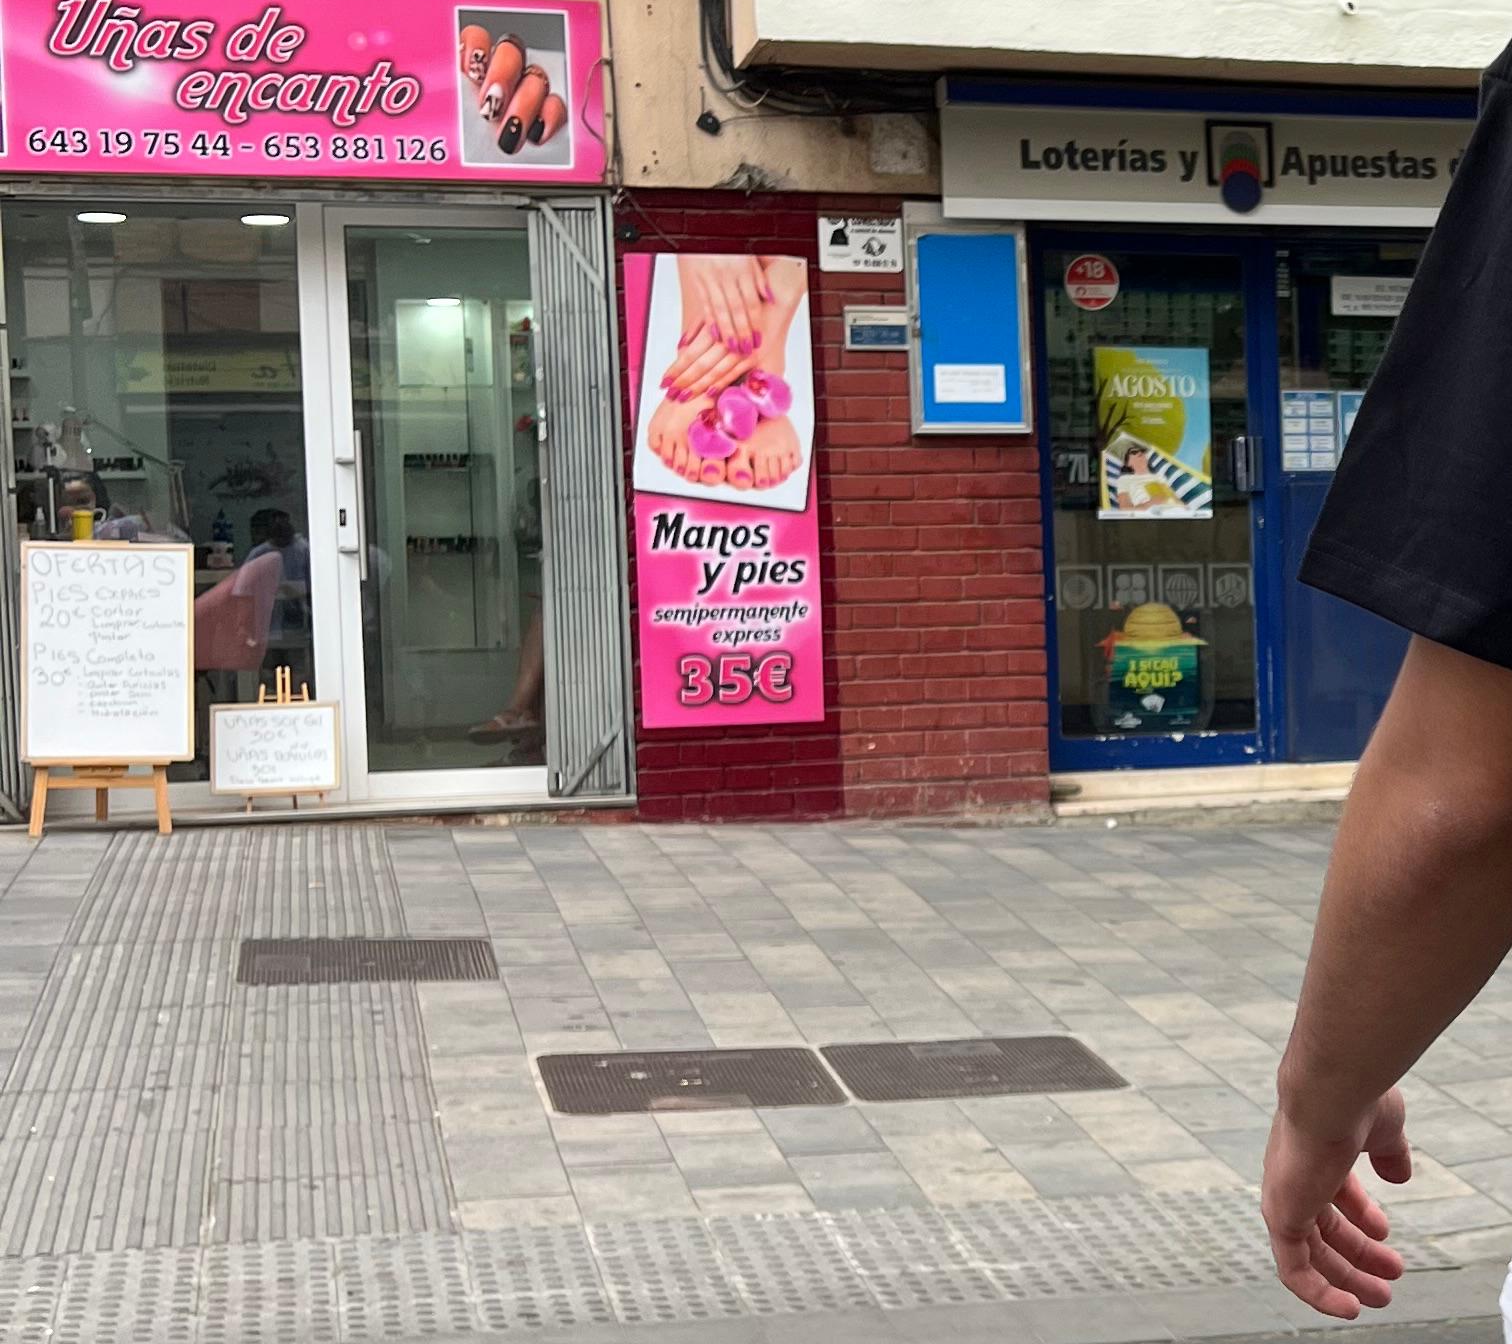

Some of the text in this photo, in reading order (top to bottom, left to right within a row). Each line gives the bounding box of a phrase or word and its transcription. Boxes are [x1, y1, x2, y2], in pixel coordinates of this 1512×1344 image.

[226, 6, 306, 64] de
[175, 61, 422, 126] encanto
[28, 129, 89, 155] 643
[99, 130, 133, 156] 19
[143, 132, 181, 157] 75
[190, 133, 231, 158] 44
[263, 135, 323, 160] 653
[331, 136, 385, 161] 881
[396, 138, 447, 163] 126
[1020, 138, 1167, 174] Loterías
[1178, 150, 1199, 183] y
[1281, 146, 1437, 186] Apuestas
[1108, 373, 1197, 398] AGOSTO
[651, 512, 770, 556] Manos
[697, 554, 806, 595] y pies
[653, 601, 809, 626] semipermanente
[712, 627, 782, 646] express
[679, 655, 793, 707] 35€
